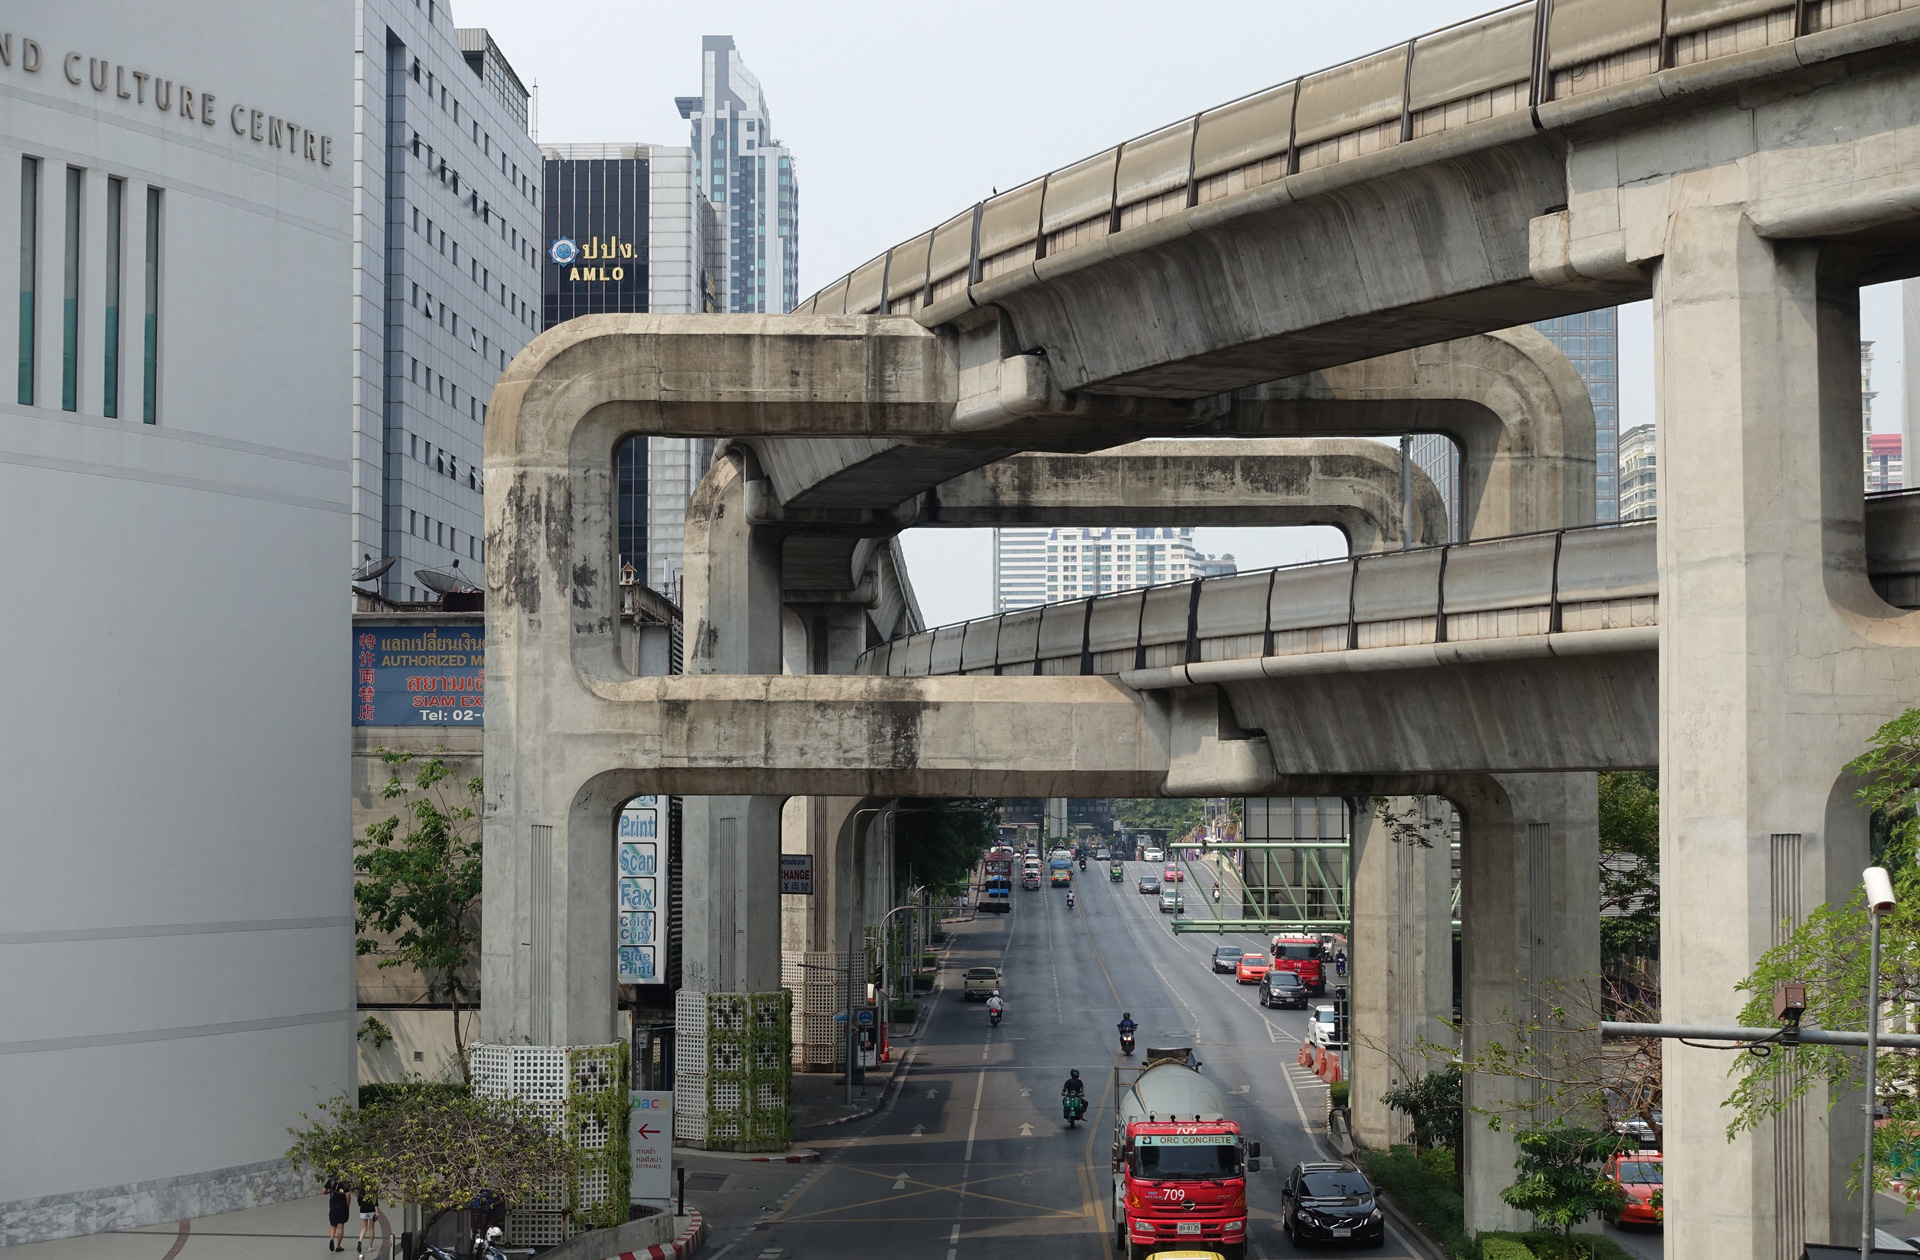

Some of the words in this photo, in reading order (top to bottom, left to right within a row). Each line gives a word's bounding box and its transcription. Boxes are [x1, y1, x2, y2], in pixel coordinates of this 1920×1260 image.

[64, 51, 216, 126] CULTURE
[230, 104, 333, 166] CENTRE
[582, 236, 638, 260] ปปง.
[569, 267, 624, 282] AMLO
[381, 628, 485, 652] แลกเปลี่ยนเงิน
[381, 655, 467, 667] AUTHORIZED
[412, 695, 456, 707] SIAM
[419, 709, 448, 721] Tel:
[452, 709, 485, 721] 02-
[620, 814, 654, 838] Print
[620, 849, 654, 872] Scan
[620, 883, 653, 906] Fax
[620, 916, 653, 927] Color
[620, 929, 652, 941] Copy
[620, 951, 651, 962] Blue
[619, 963, 652, 975] Print
[632, 1096, 667, 1108] bacc
[1160, 1136, 1179, 1144] ORC
[1182, 1136, 1231, 1144] CONCRETE
[1163, 1188, 1185, 1201] 709
